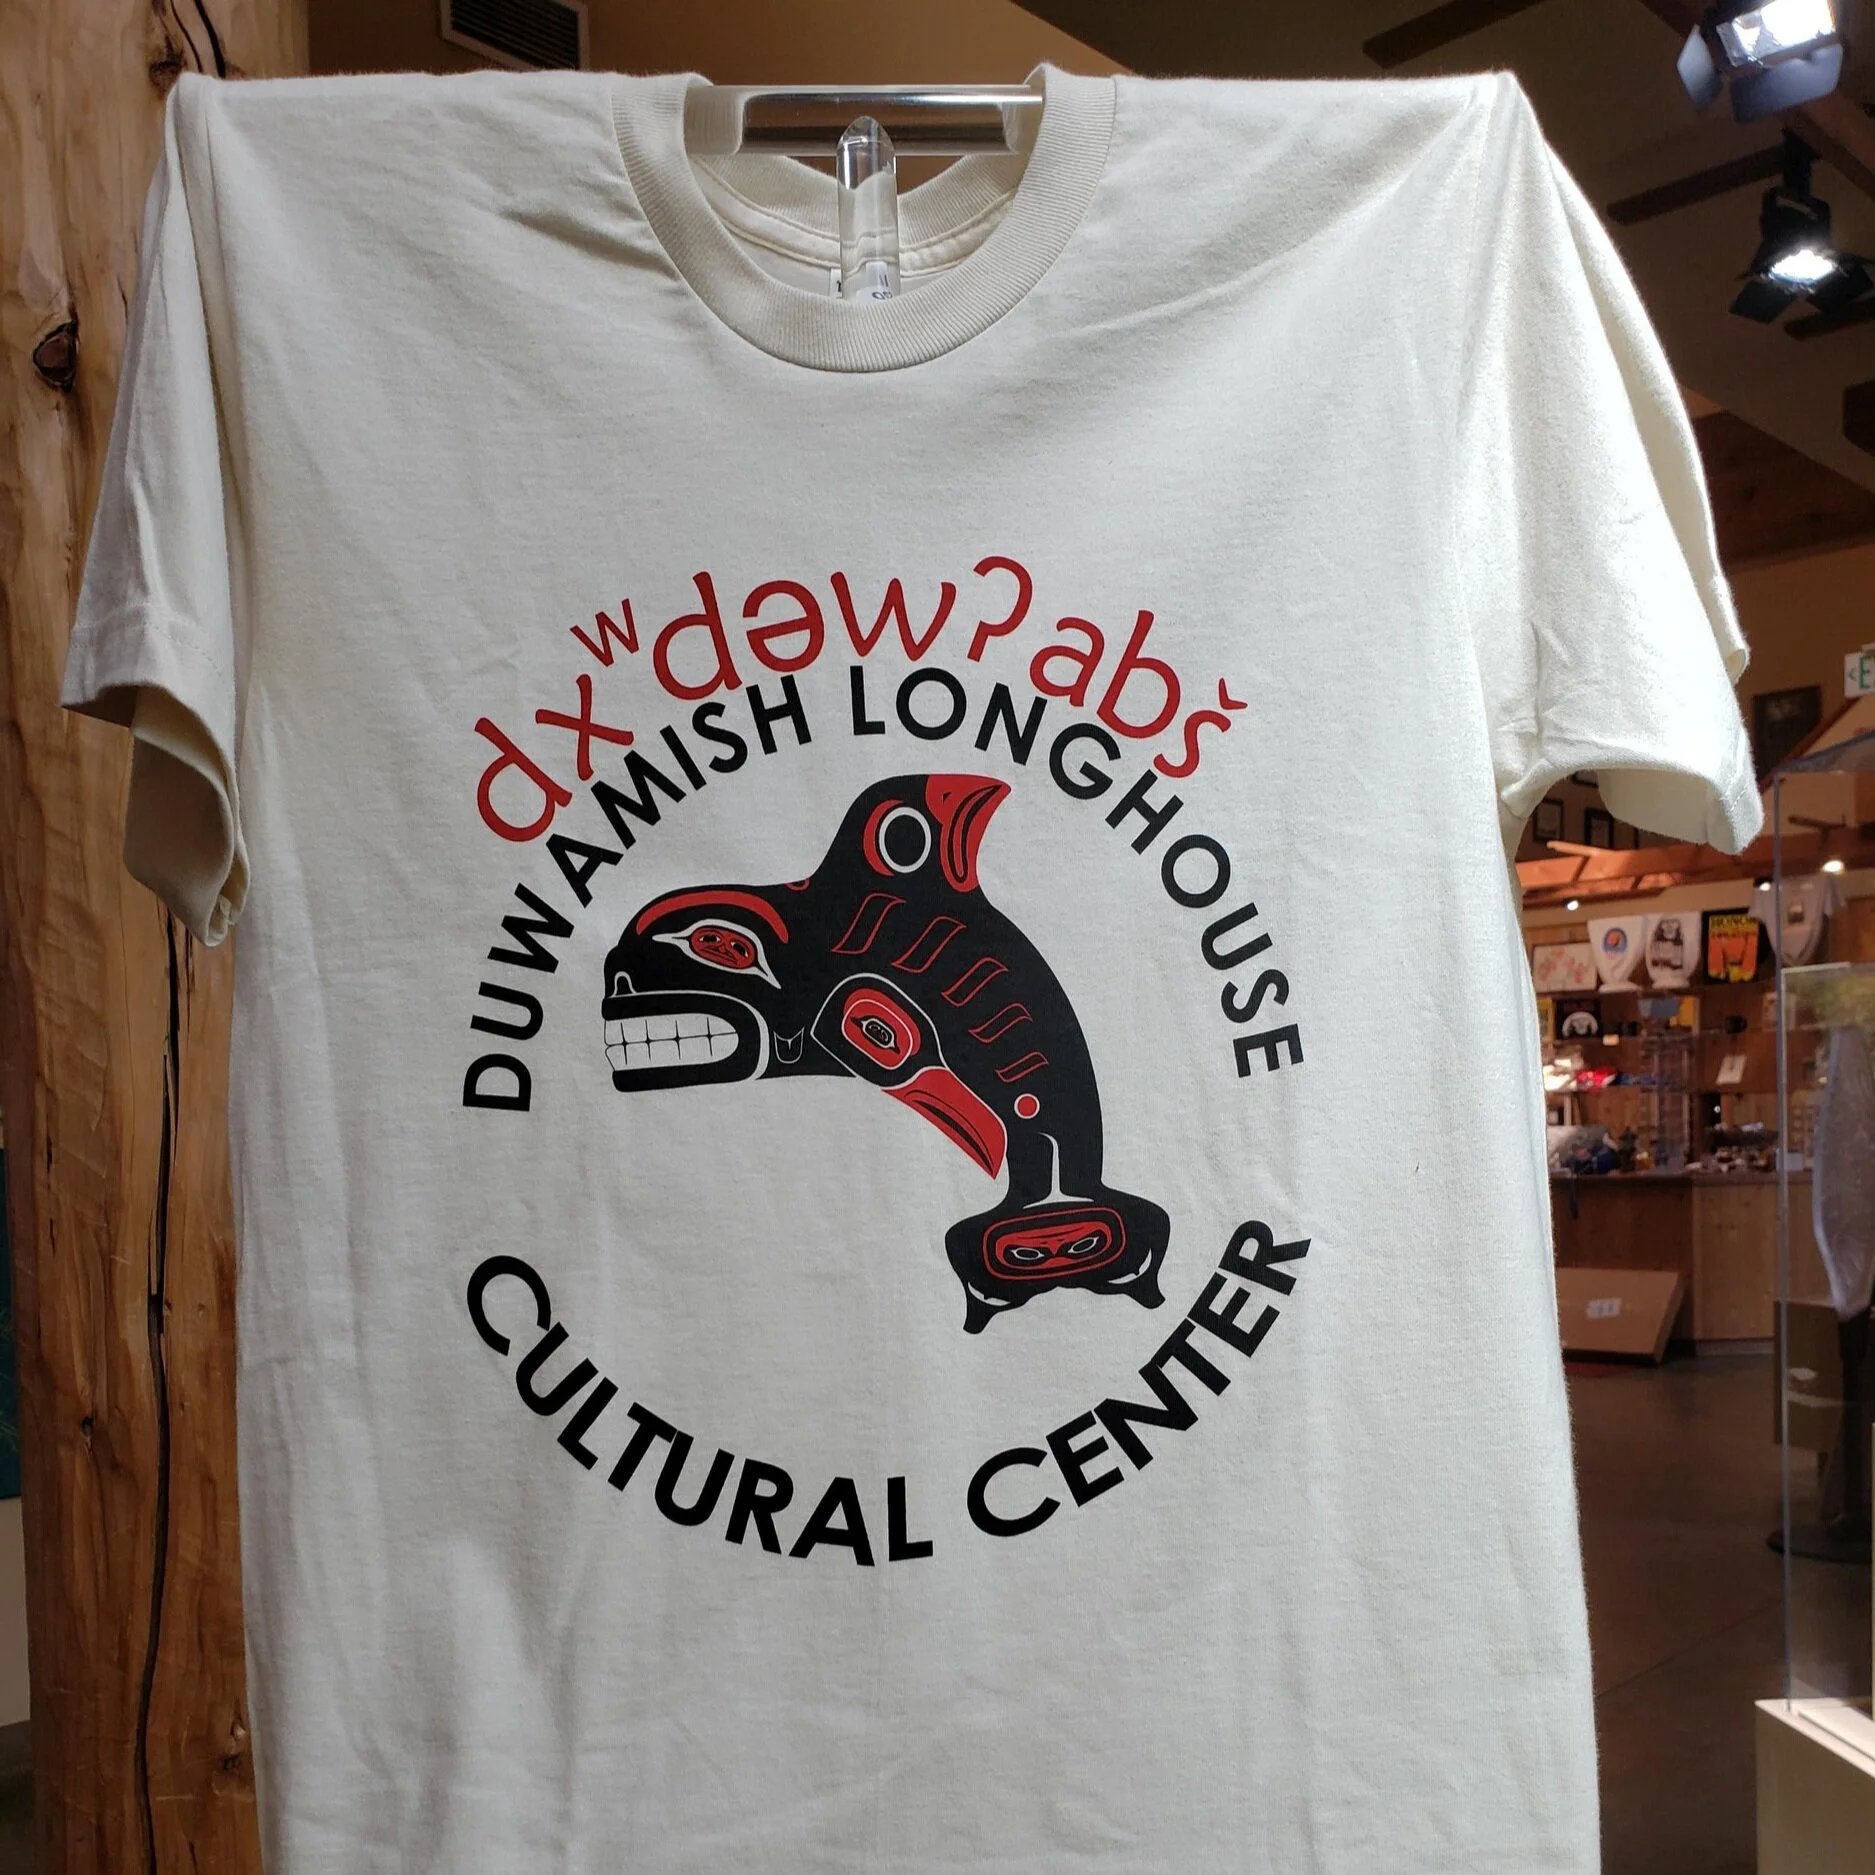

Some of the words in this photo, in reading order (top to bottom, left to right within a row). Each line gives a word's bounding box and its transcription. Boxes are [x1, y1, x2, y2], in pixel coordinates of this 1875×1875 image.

[463, 674, 813, 1112] DUWAMISH
[849, 666, 1304, 1078] LONGHOUSE
[466, 1255, 934, 1567] CULTURAL
[966, 1219, 1312, 1538] CENTER
